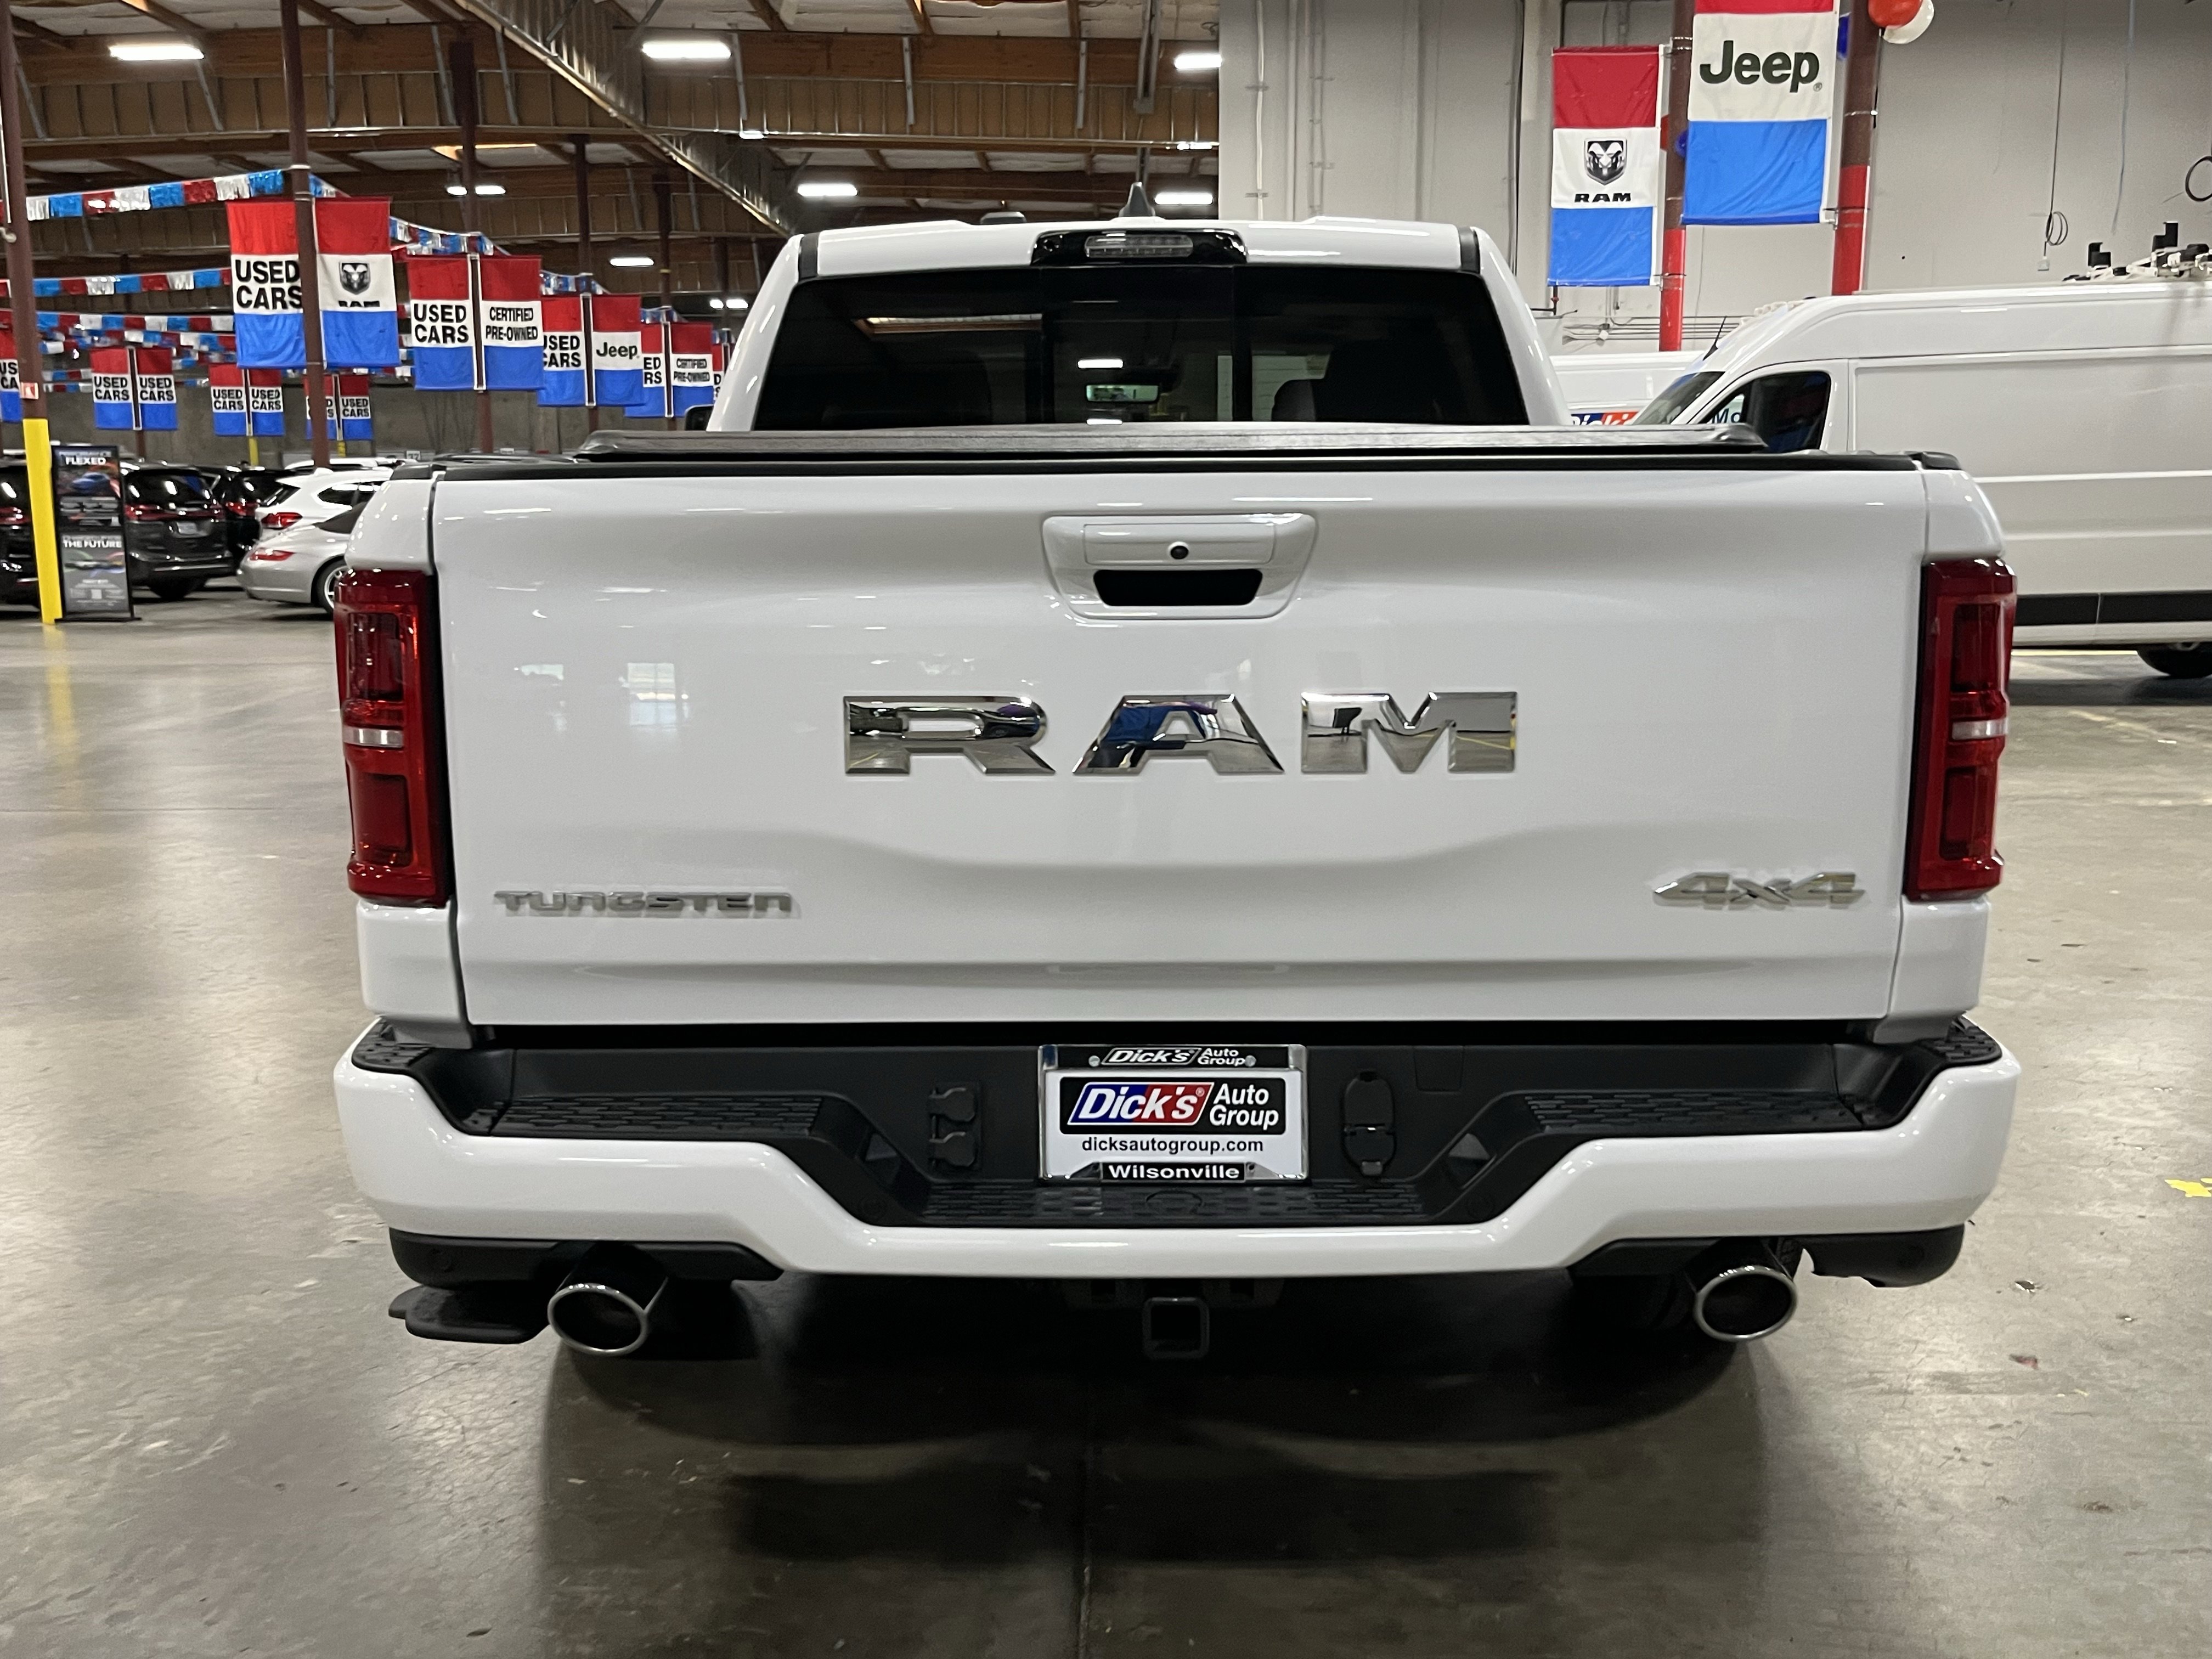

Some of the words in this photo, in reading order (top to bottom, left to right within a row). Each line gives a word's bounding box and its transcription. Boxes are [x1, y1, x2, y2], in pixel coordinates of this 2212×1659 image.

[1700, 40, 1819, 93] Jeep
[1574, 193, 1631, 202] RAM
[235, 259, 300, 284] USED
[236, 285, 302, 310] CARS
[414, 303, 466, 323] USED
[489, 307, 533, 321] CERTIFIED
[415, 324, 469, 343] CARS
[486, 325, 538, 341] PRE-OWNED
[596, 342, 637, 360] Jeep
[94, 376, 127, 388] USED
[139, 377, 172, 388] USED
[95, 389, 129, 400] CARS
[140, 390, 174, 401] CARS
[213, 389, 242, 399] USED
[251, 389, 280, 399] USED
[214, 400, 244, 410] CARS
[252, 400, 281, 410] CARS
[342, 398, 368, 407] USED
[342, 409, 369, 417] CARS
[84, 540, 122, 548] FUTURE
[843, 691, 1517, 774] RAM
[1109, 1049, 1190, 1062] Dick's
[1201, 1048, 1239, 1057] Auto
[1197, 1056, 1245, 1066] Group
[1213, 1084, 1269, 1105] Auto
[1078, 1087, 1197, 1120] Dick's
[1209, 1104, 1279, 1130] Group
[1082, 1137, 1263, 1155] dicksautogroup.com
[1108, 1165, 1239, 1179] Wilsonville
